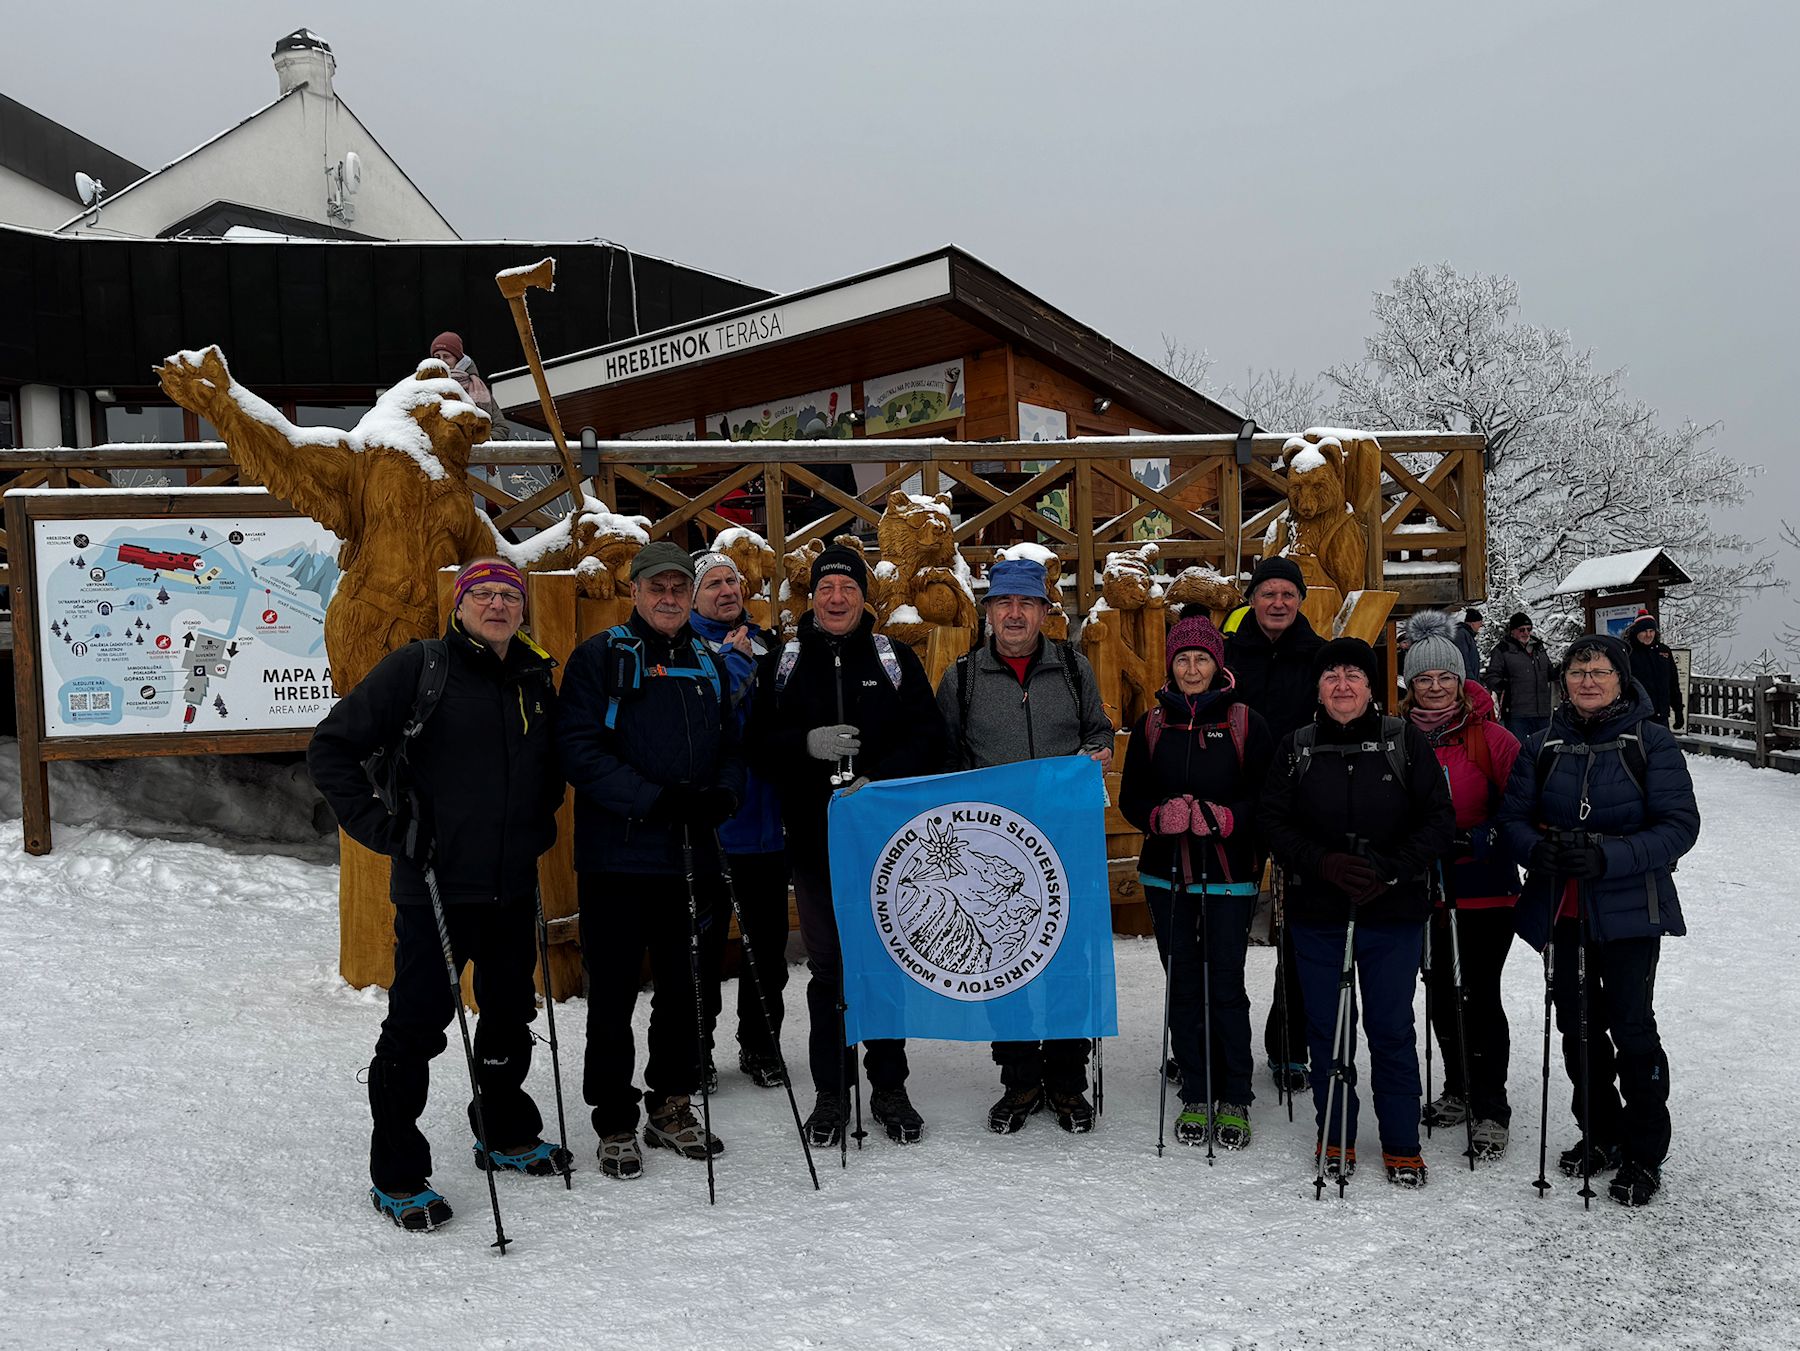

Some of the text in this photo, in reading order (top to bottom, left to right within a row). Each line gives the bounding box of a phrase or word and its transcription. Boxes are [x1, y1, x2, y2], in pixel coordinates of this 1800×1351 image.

[606, 313, 782, 380] HREBIENOK TERASA
[263, 668, 316, 683] MAPA
[269, 705, 295, 715] AREA
[297, 704, 320, 713] MAP
[876, 828, 936, 983] DUBNICA NAD VÁHOM
[952, 810, 1061, 993] KLUB SLOVENSKÝCH TURISTOV
